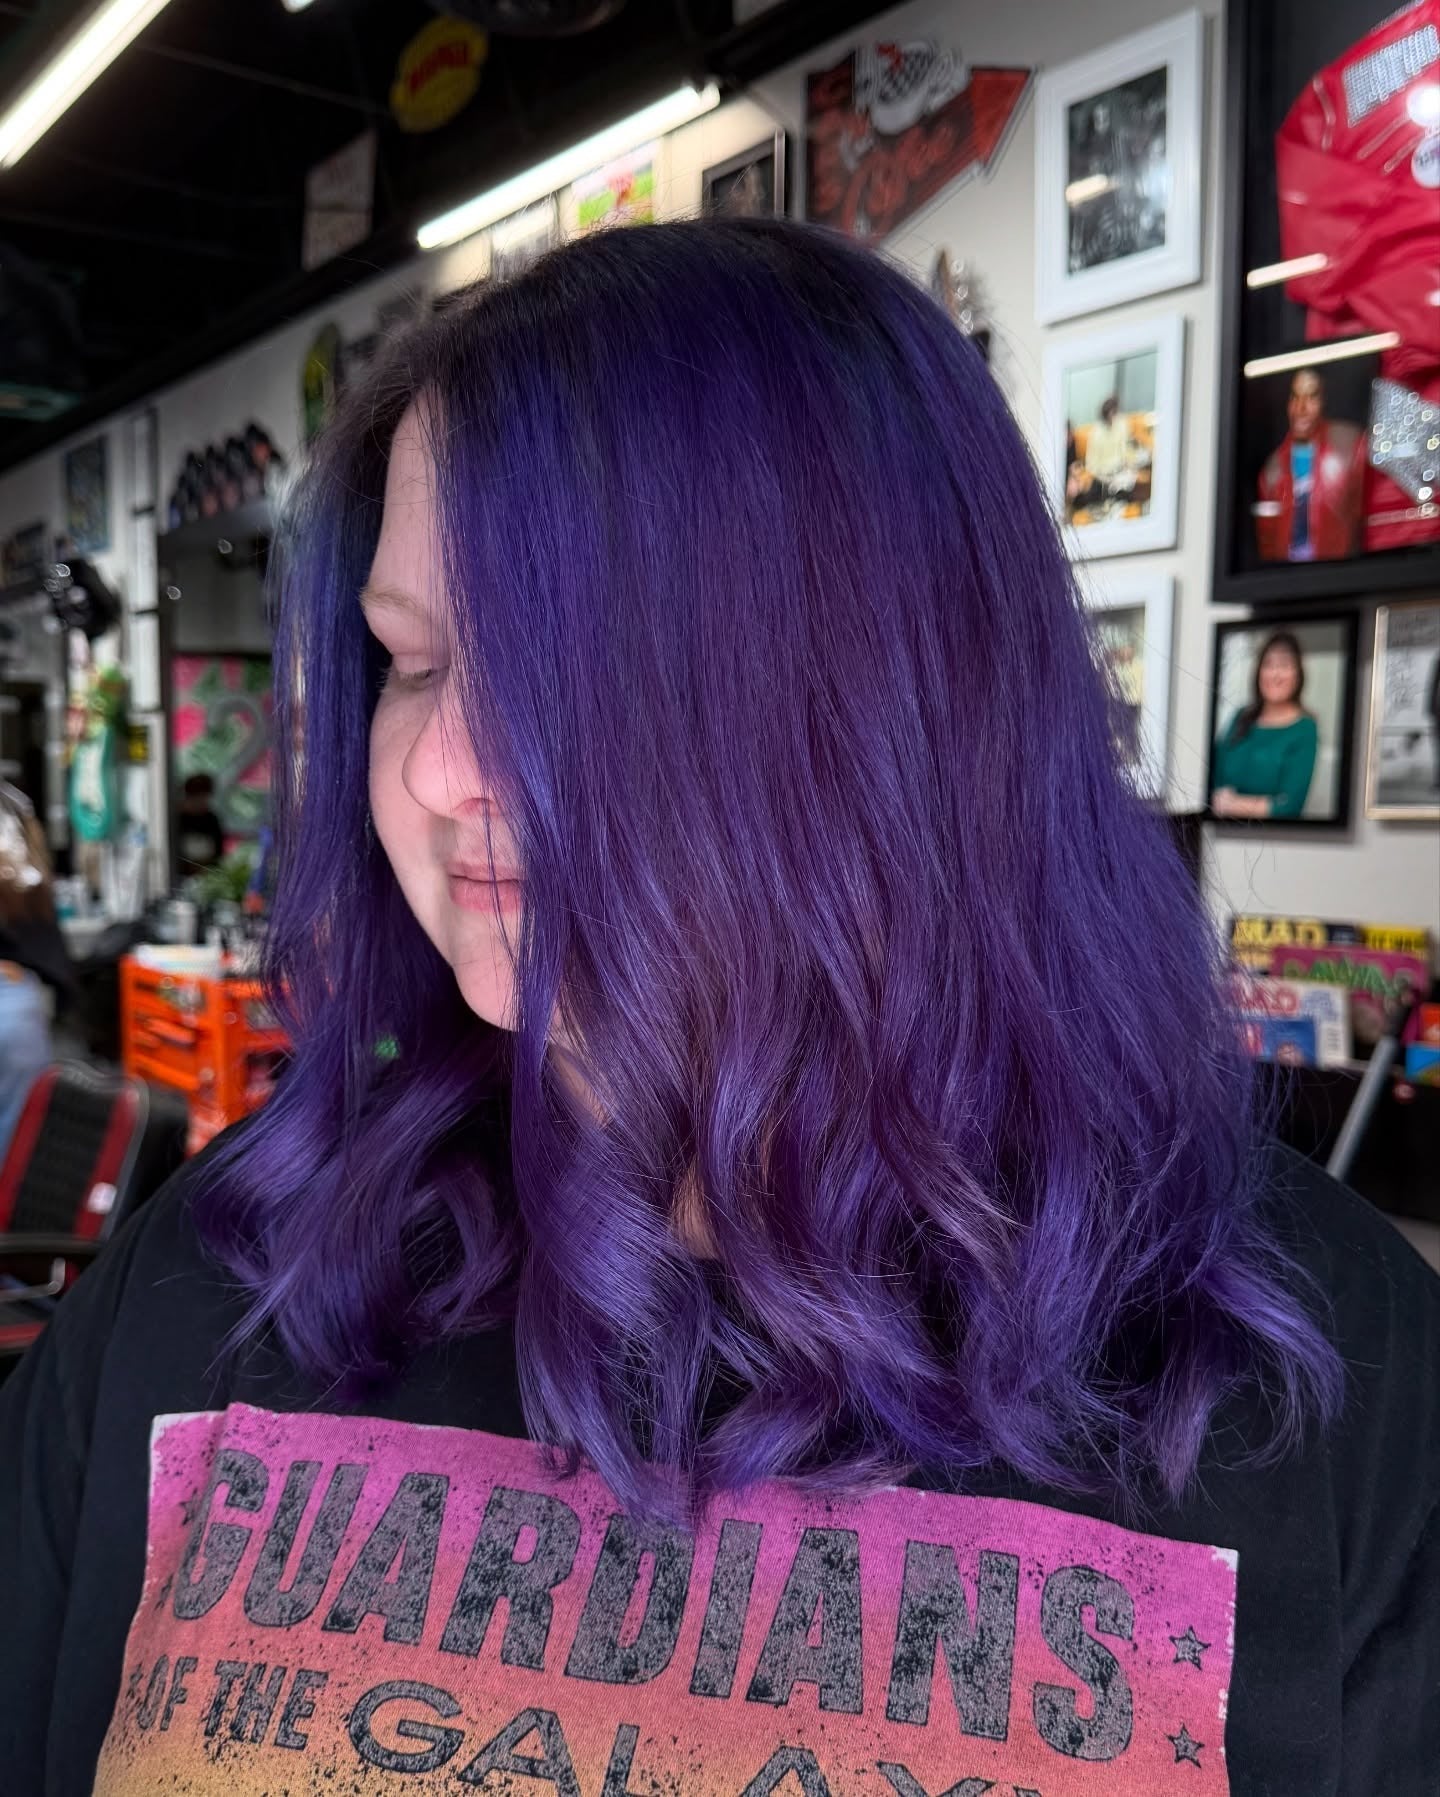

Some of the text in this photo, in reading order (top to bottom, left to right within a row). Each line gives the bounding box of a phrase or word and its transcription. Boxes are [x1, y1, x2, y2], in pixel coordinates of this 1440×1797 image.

[136, 1654, 200, 1732] OF
[203, 1660, 329, 1750] THE
[173, 1449, 1135, 1762] GUARDIANS
